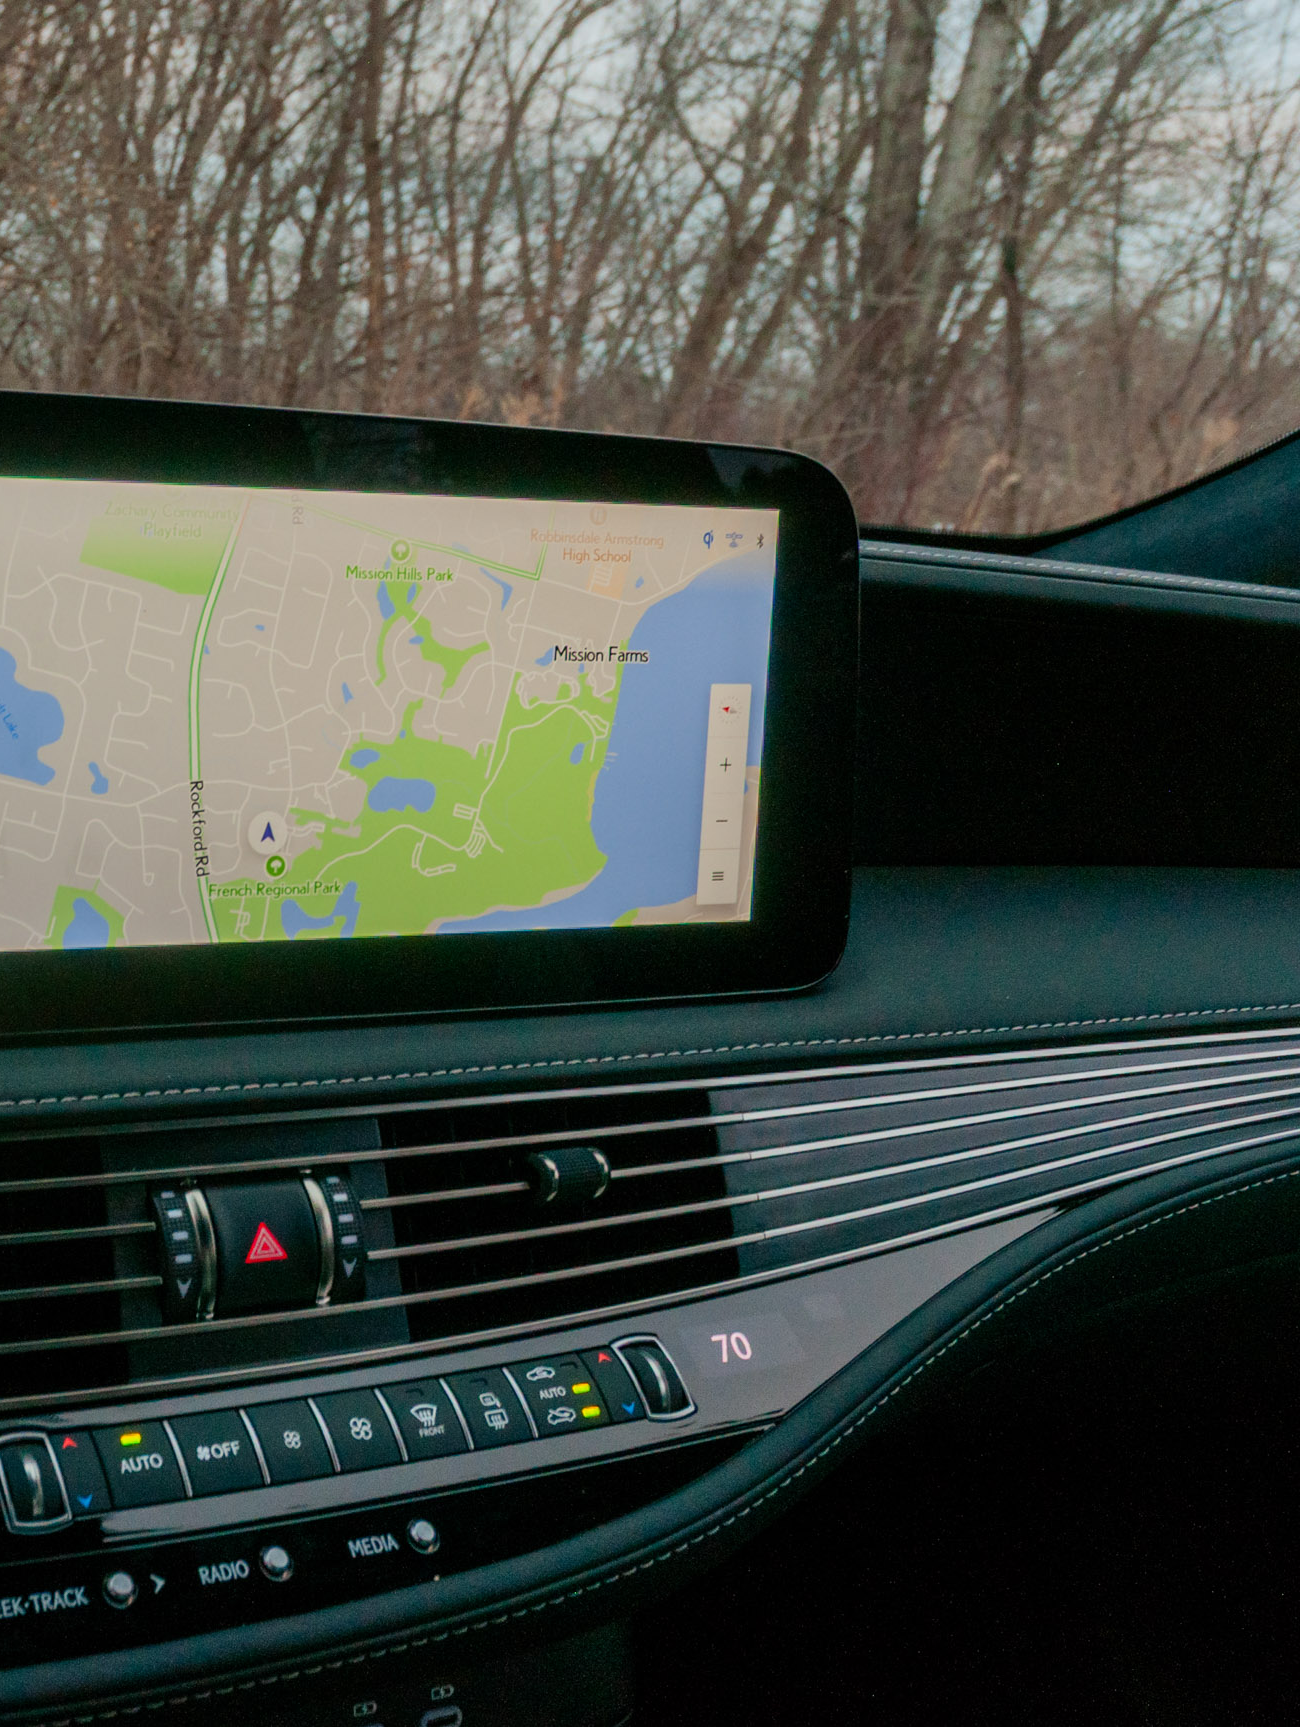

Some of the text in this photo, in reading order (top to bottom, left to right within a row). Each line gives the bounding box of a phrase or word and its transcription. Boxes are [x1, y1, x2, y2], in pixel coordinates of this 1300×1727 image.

[105, 501, 240, 523] Zachary Community
[143, 521, 202, 539] Playfield
[530, 528, 664, 549] Robbinsdale Armstrong
[562, 547, 632, 563] High School
[346, 565, 454, 582] Mission Hills Park
[554, 645, 649, 664] Mission Farms
[190, 780, 210, 877] Rockford Rd
[208, 880, 341, 898] French Regional Park
[711, 1332, 753, 1363] 70
[539, 1386, 566, 1400] AUTO
[419, 1424, 445, 1438] FRONT
[211, 1440, 240, 1460] OFF
[120, 1454, 163, 1475] AUTO
[347, 1533, 399, 1559] MEDIA
[198, 1560, 249, 1586] RADIO
